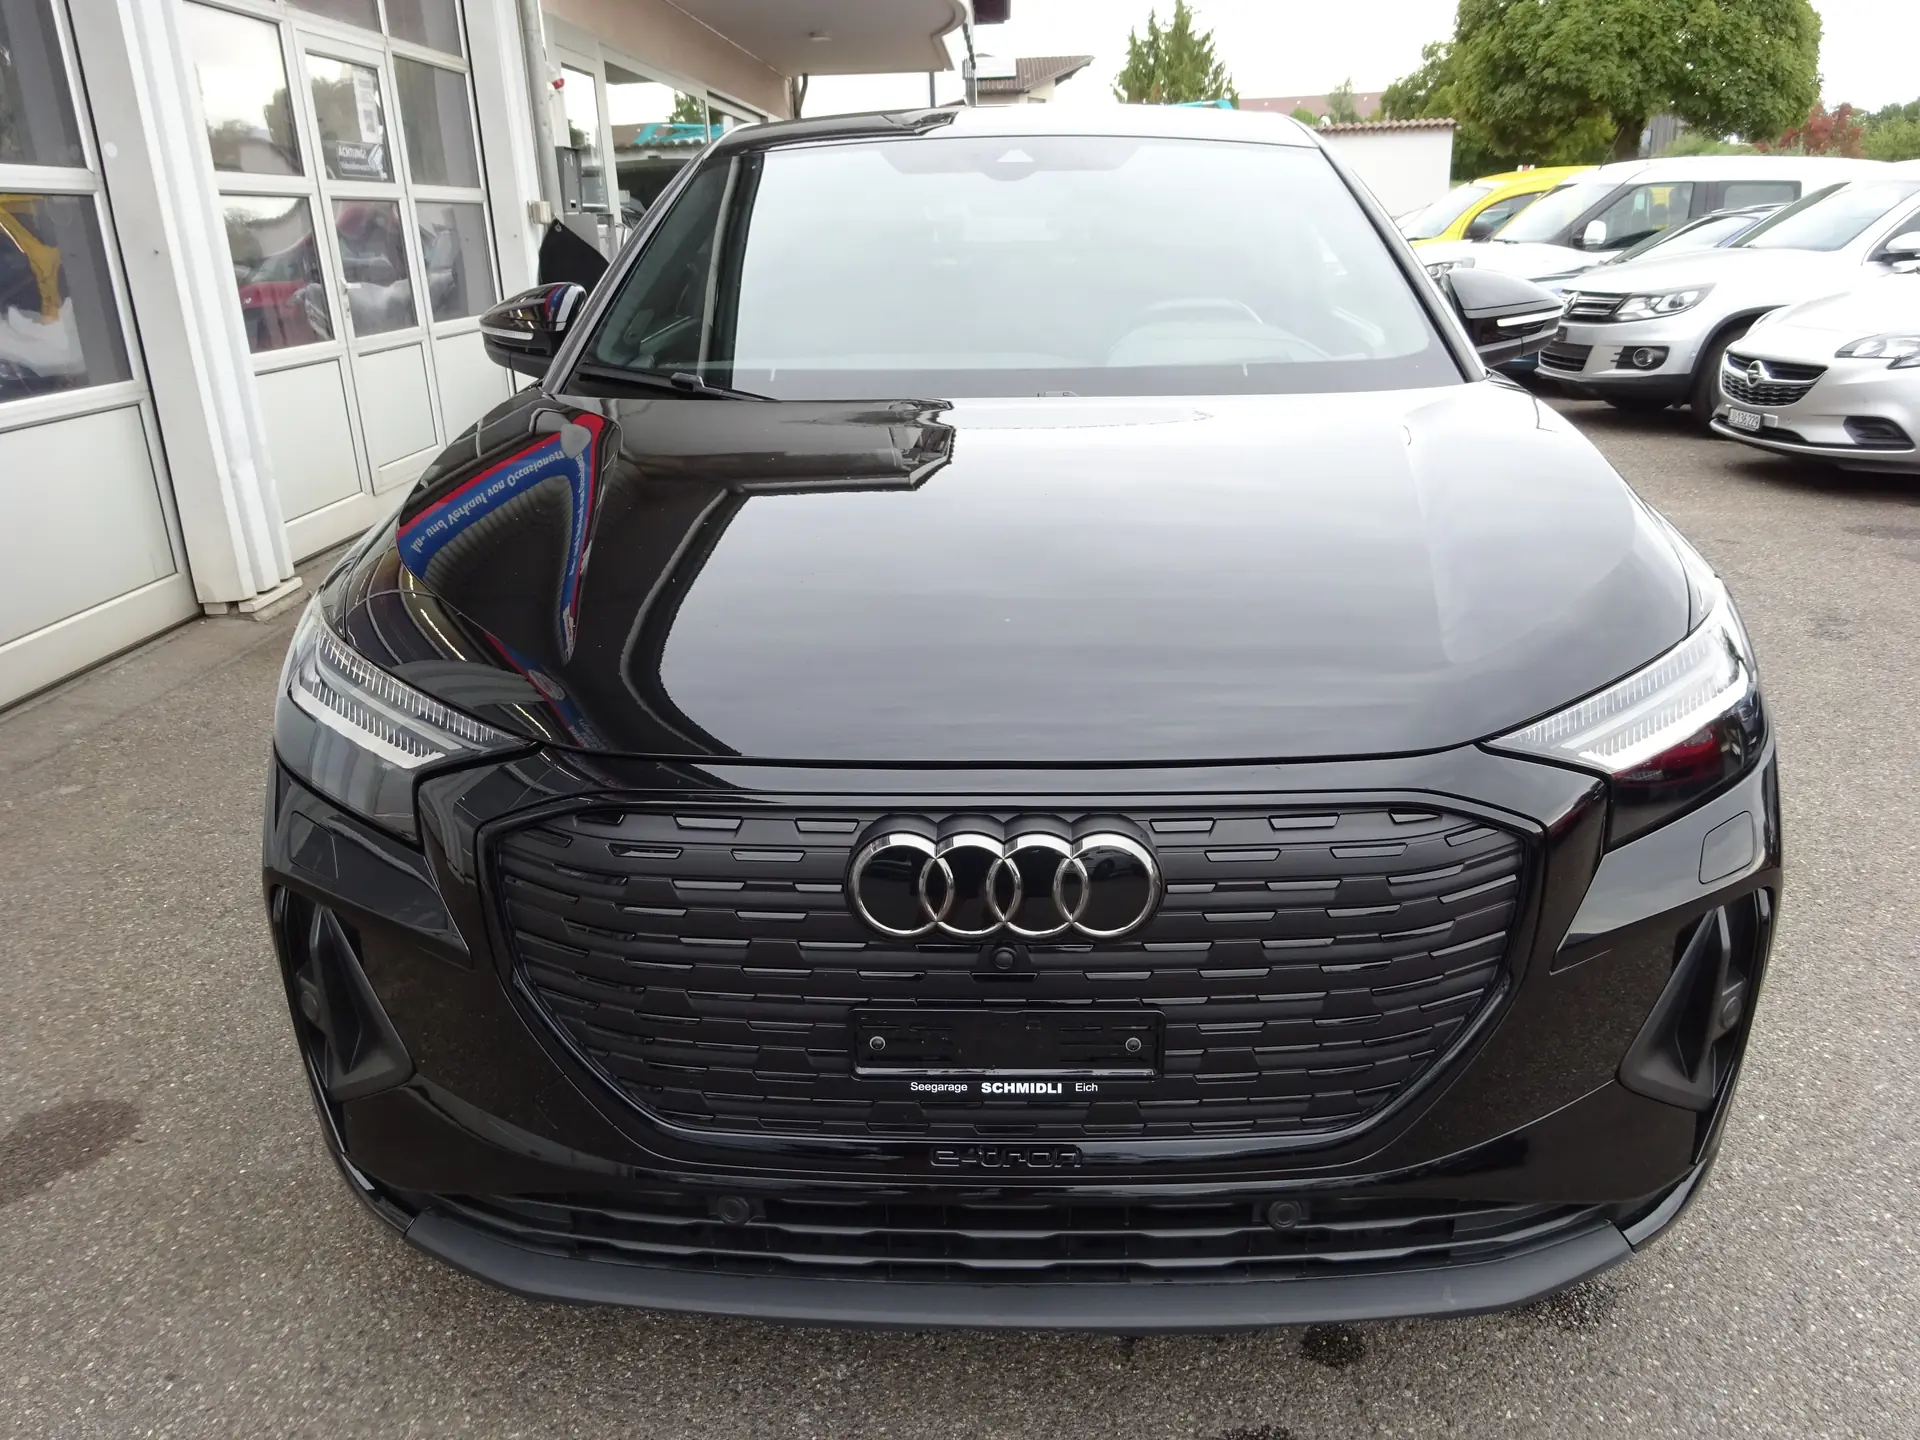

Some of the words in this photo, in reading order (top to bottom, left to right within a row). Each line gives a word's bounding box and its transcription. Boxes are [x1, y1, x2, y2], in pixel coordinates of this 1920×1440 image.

[910, 1081, 968, 1093] Seegarage
[981, 1082, 1062, 1094] SCHMIDLI
[1075, 1082, 1099, 1092] Eich
[930, 1145, 1083, 1168] e-tron
